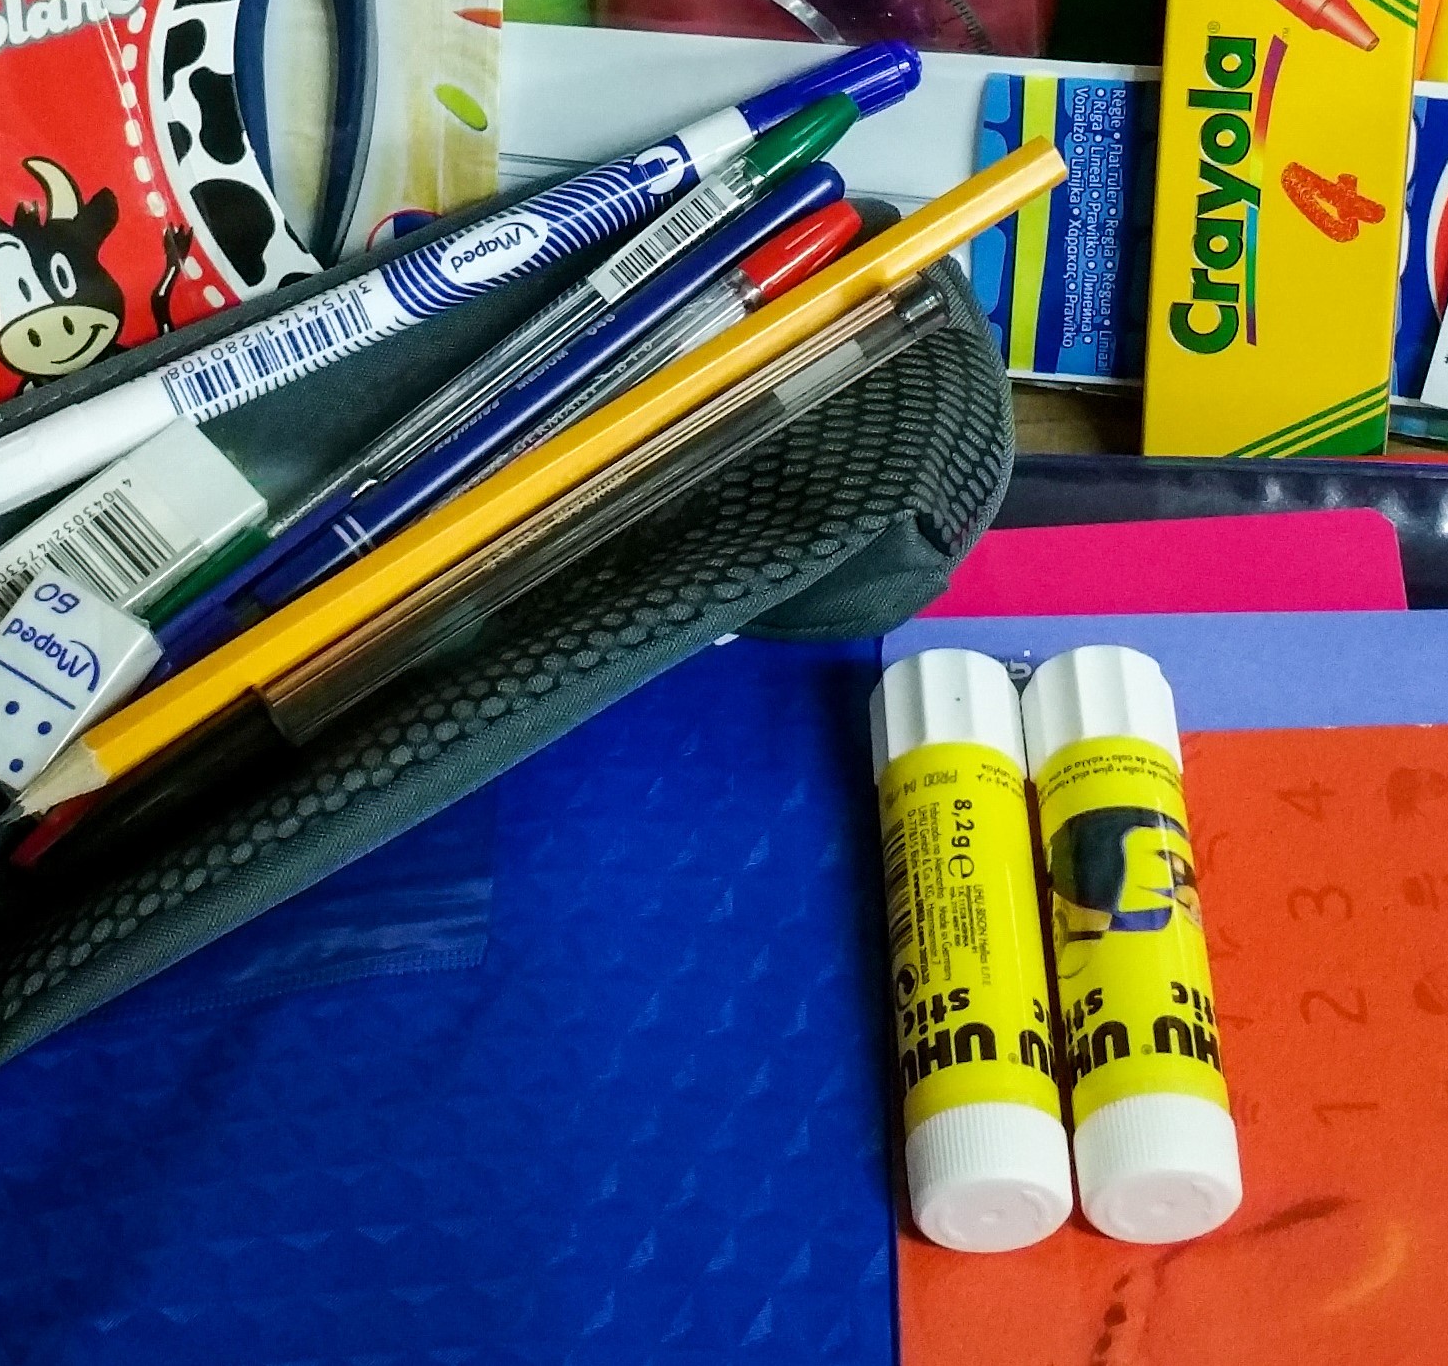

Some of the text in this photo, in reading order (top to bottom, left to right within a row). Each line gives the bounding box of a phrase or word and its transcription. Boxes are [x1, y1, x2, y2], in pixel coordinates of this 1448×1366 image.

[1089, 100, 1105, 131] Riga
[1109, 89, 1127, 128] Règle
[1087, 146, 1104, 187] Lineal
[1107, 143, 1123, 170] Flat
[1105, 172, 1122, 204] ruler
[1168, 35, 1261, 356] Crayola
[1280, 160, 1386, 244] 4
[449, 215, 548, 278] Maped
[1101, 219, 1119, 256] Regla
[1098, 272, 1117, 316] Régua
[167, 280, 372, 381] 3 154141 280108
[50, 491, 118, 542] 043032
[1, 617, 101, 693] Maped
[952, 796, 976, 850] 8,2g
